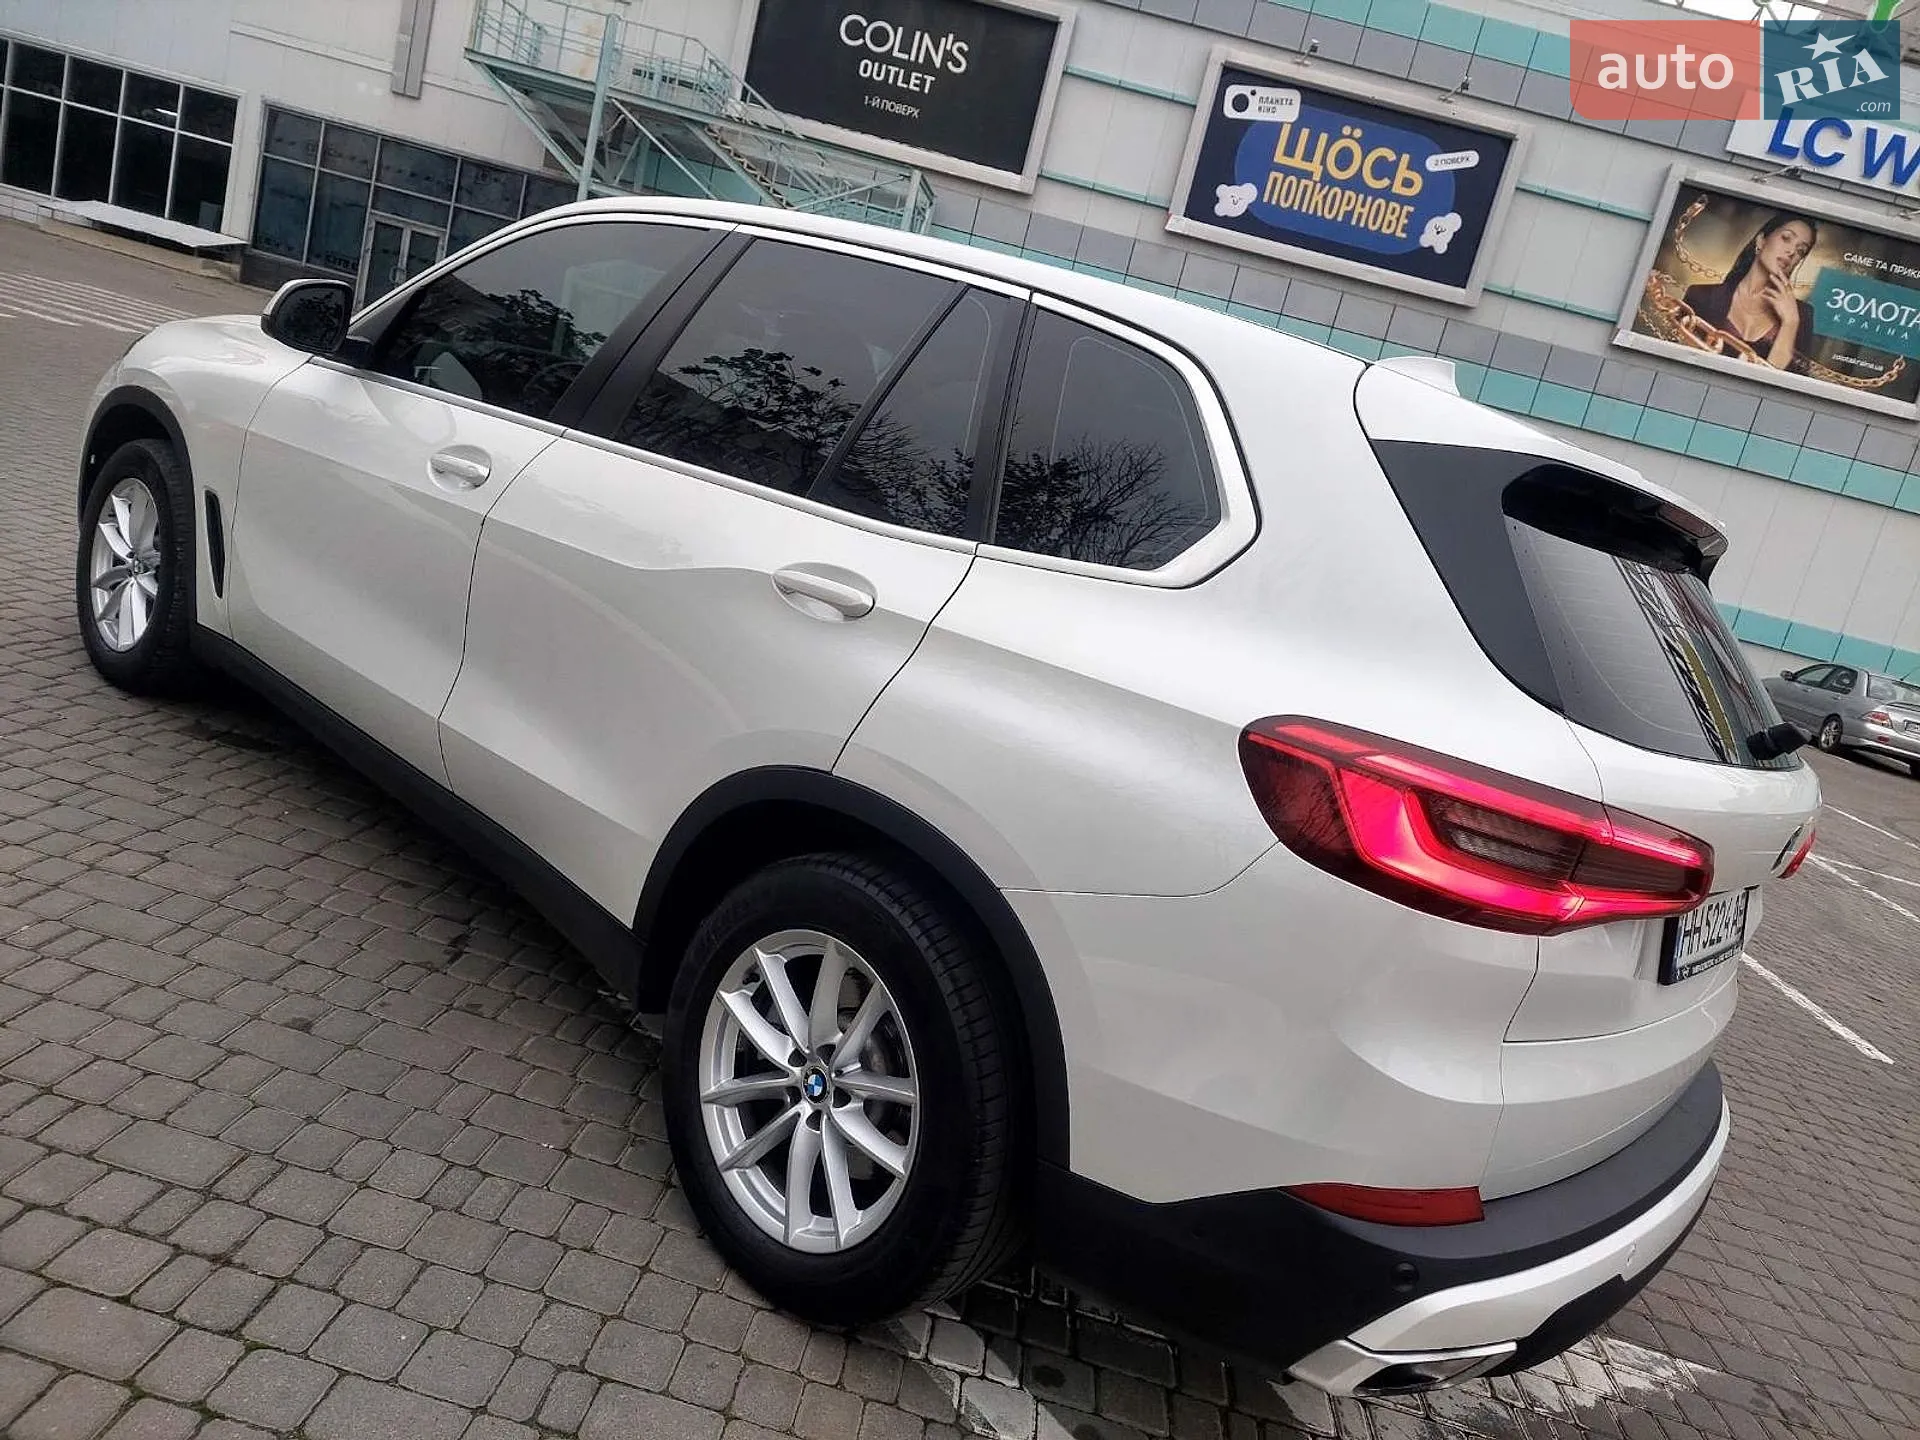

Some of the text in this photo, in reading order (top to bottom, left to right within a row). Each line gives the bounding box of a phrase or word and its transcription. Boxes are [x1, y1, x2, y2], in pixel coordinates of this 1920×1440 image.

[839, 14, 969, 74] COLIN'S
[858, 58, 936, 95] OUTLET
[880, 99, 920, 119] ПОВЕРХ
[1767, 107, 1853, 167] LC
[1263, 171, 1416, 240] ПОПКОРНОВЕ
[1843, 252, 1874, 267] САМЕ
[1889, 263, 1920, 279] ПРИК
